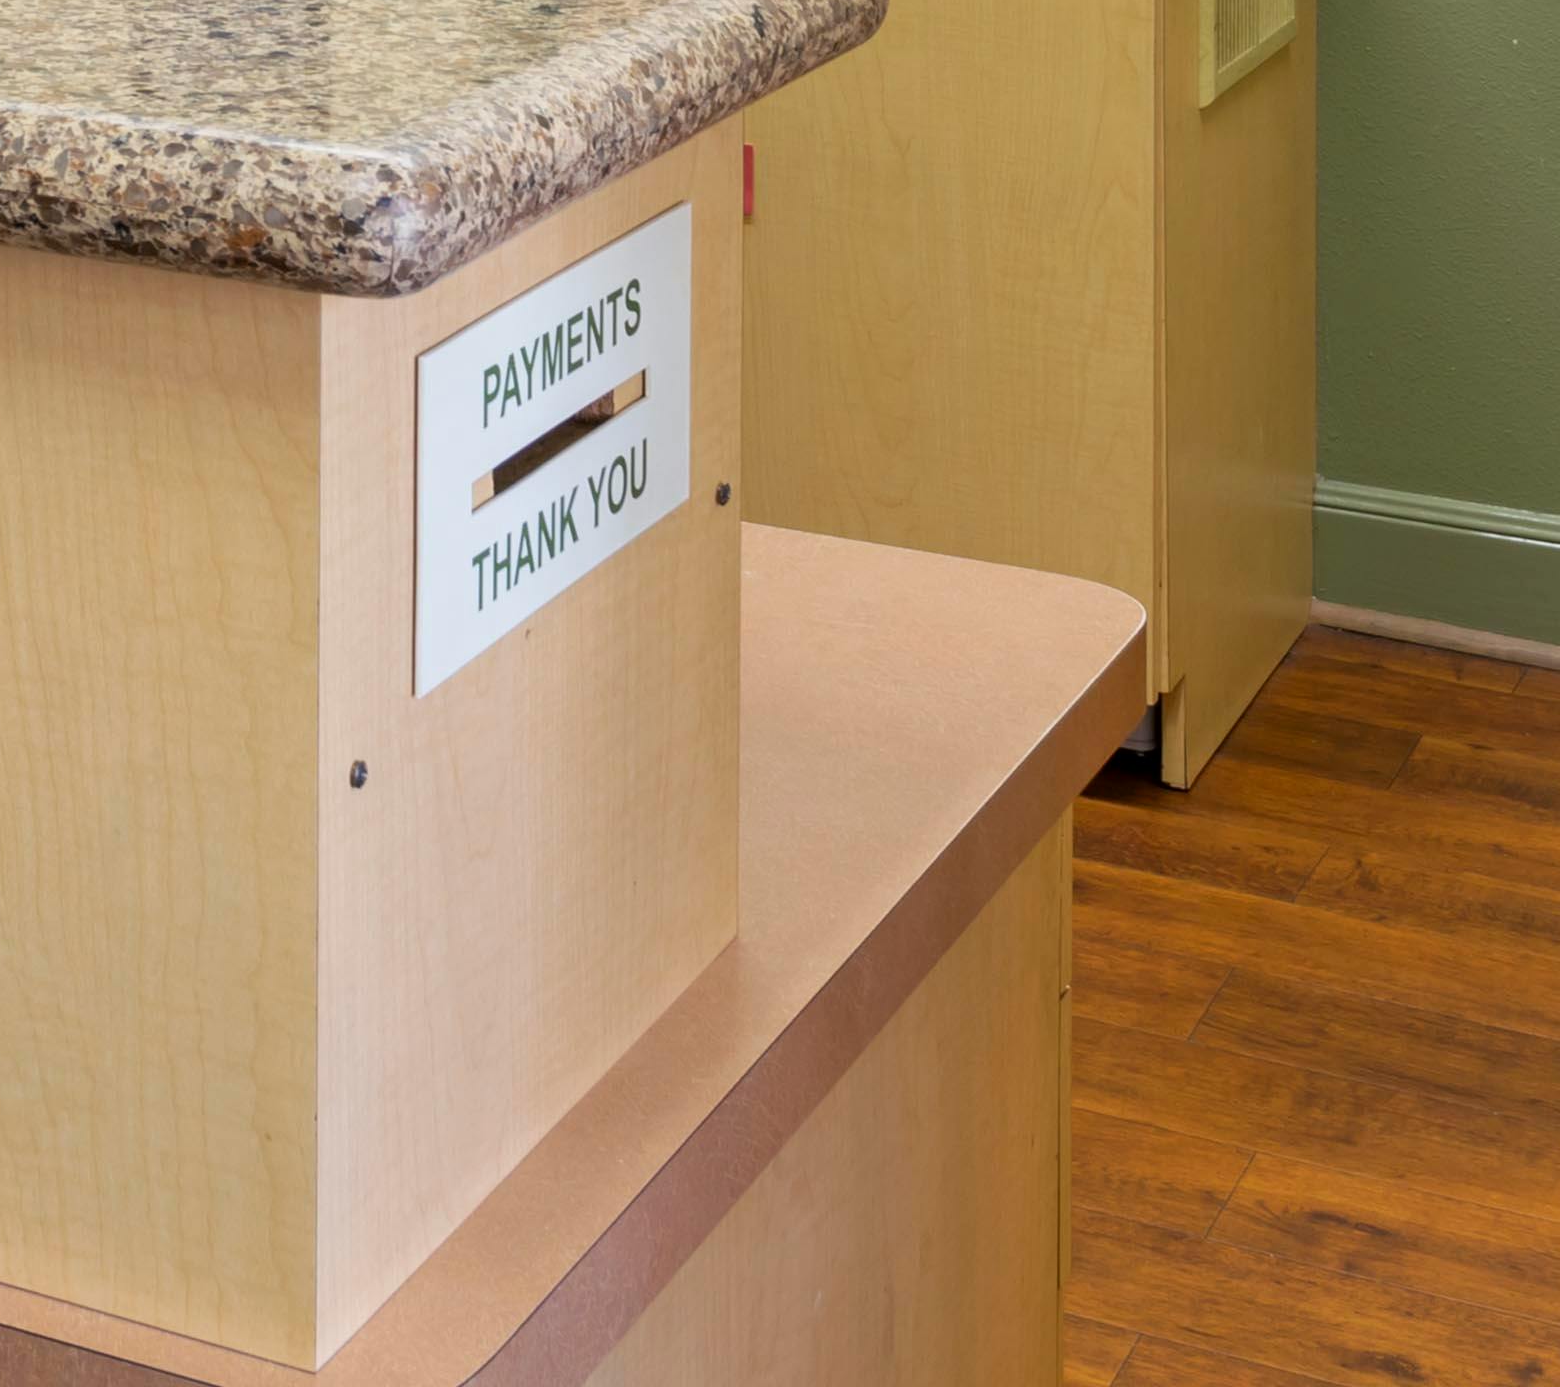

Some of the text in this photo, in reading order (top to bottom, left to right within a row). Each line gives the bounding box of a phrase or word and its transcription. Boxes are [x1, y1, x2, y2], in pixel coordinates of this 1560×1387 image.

[482, 278, 641, 429] PAYMENTS
[471, 437, 648, 612] THANK YOU
